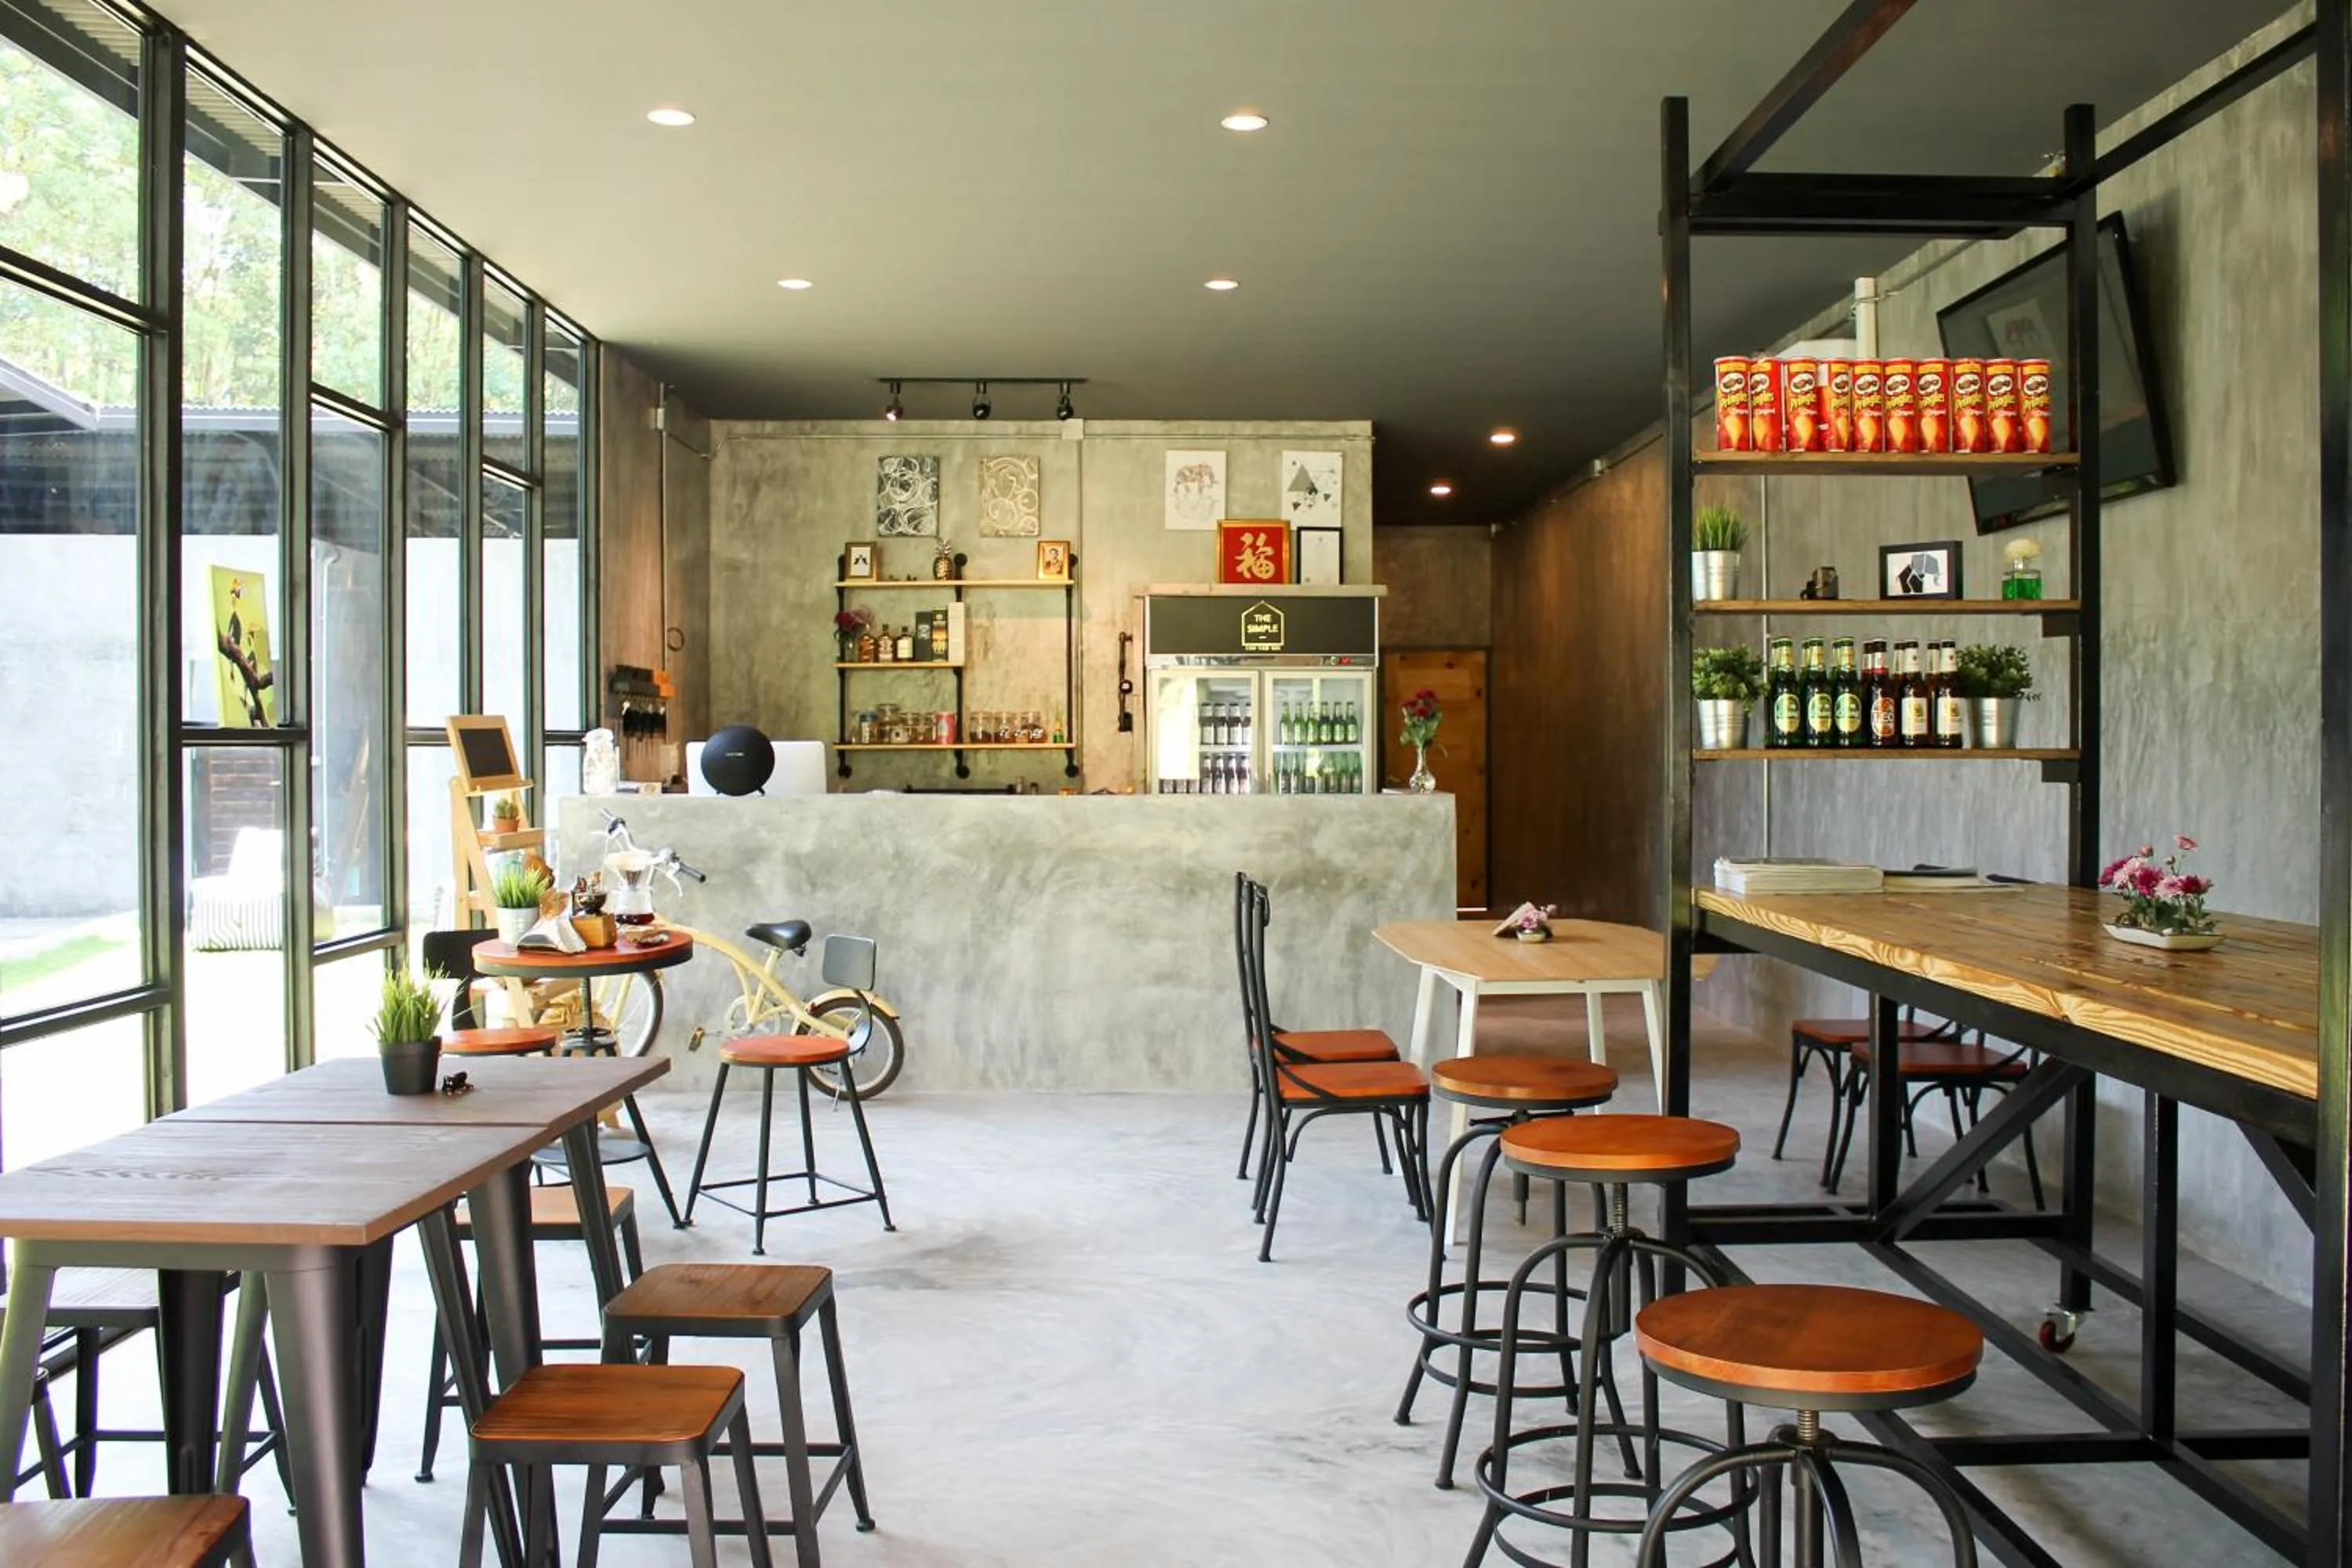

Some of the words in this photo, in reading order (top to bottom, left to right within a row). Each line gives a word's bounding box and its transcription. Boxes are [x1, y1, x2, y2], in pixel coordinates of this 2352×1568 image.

[1235, 532, 1275, 579] 福
[1254, 614, 1272, 622] THE
[1247, 624, 1279, 633] SIMPLE
